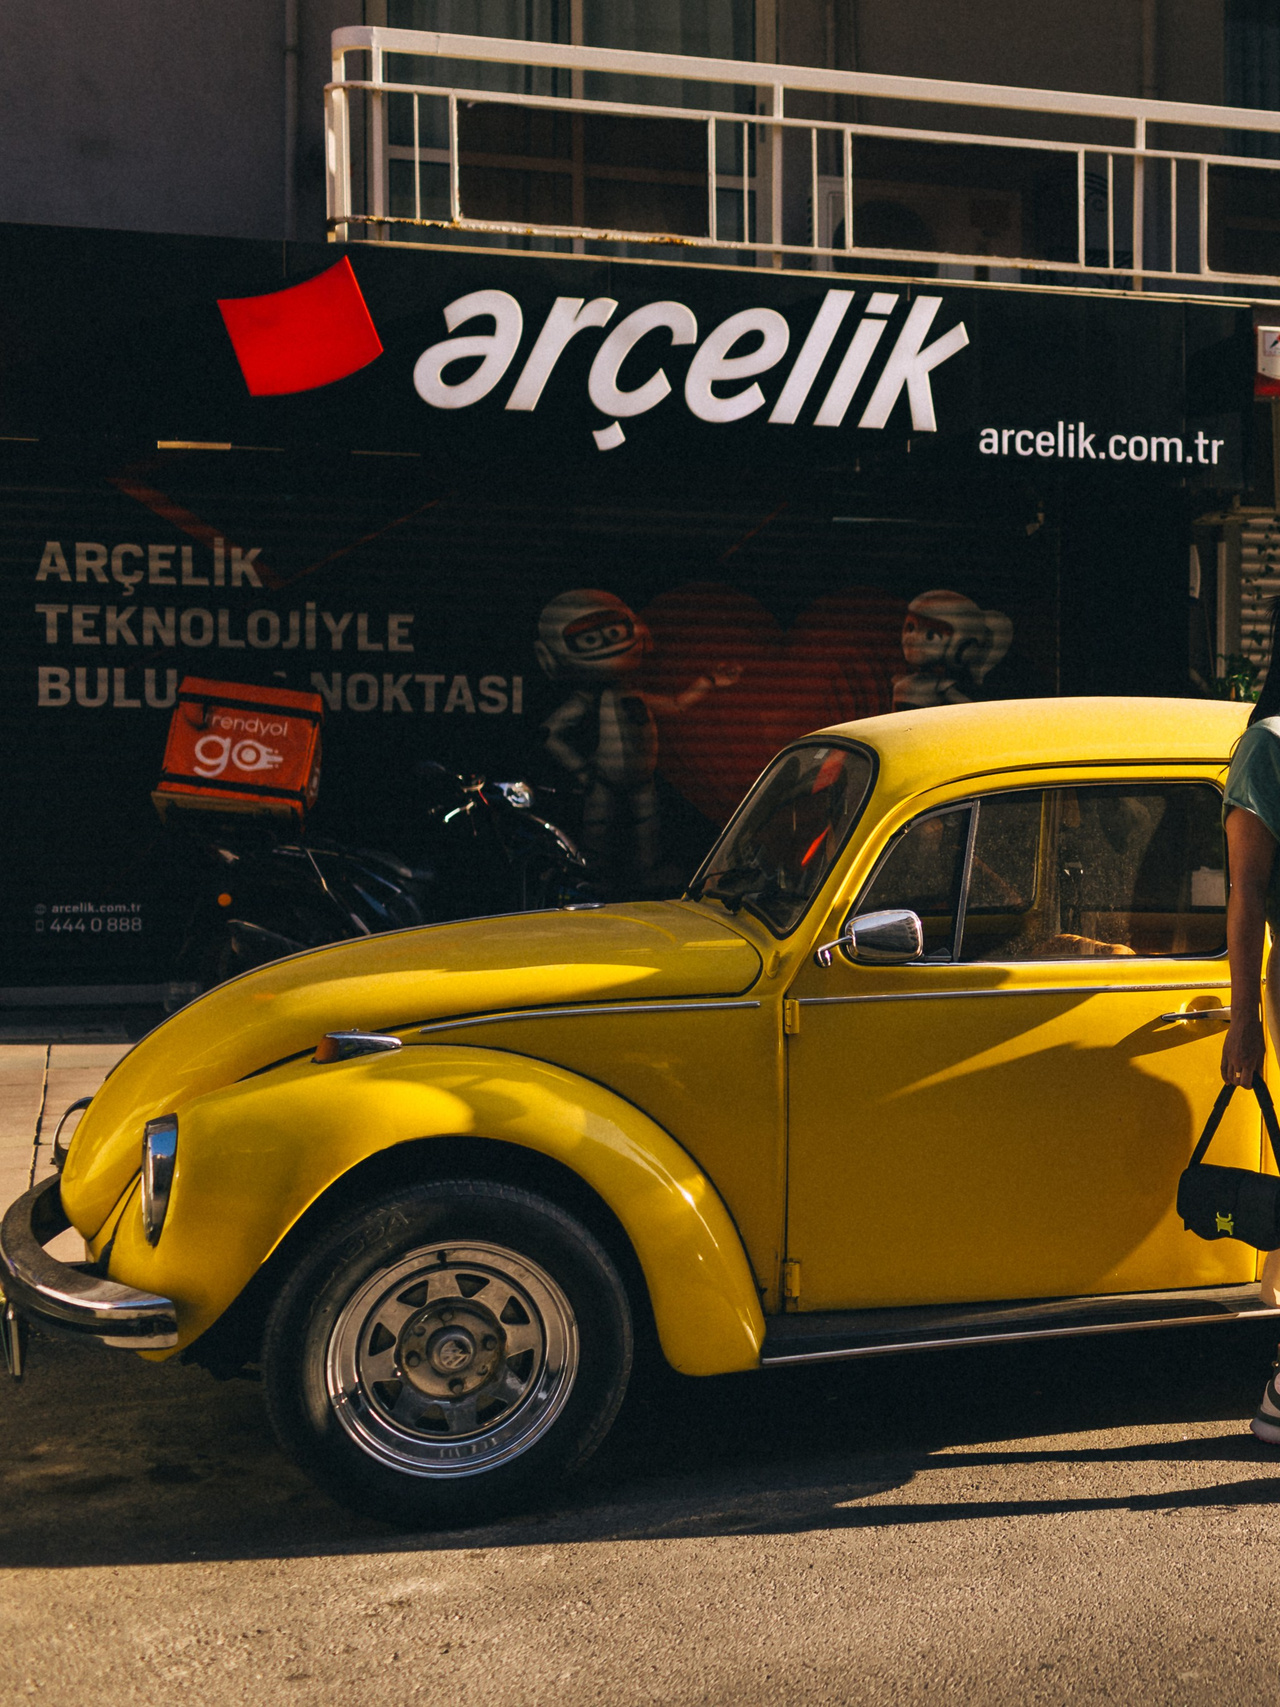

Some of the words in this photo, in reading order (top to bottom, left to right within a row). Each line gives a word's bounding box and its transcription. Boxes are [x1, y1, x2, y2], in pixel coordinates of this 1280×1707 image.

[413, 289, 970, 451] arçelik
[979, 421, 1225, 465] arcelik.com.tr
[35, 536, 263, 595] ARÇELİK
[35, 600, 415, 653] TEKNOLOJİYLE
[310, 671, 524, 715] NOKTASI
[50, 917, 86, 932] 444
[107, 917, 142, 932] 888
[51, 902, 142, 914] arcelik.com.tr
